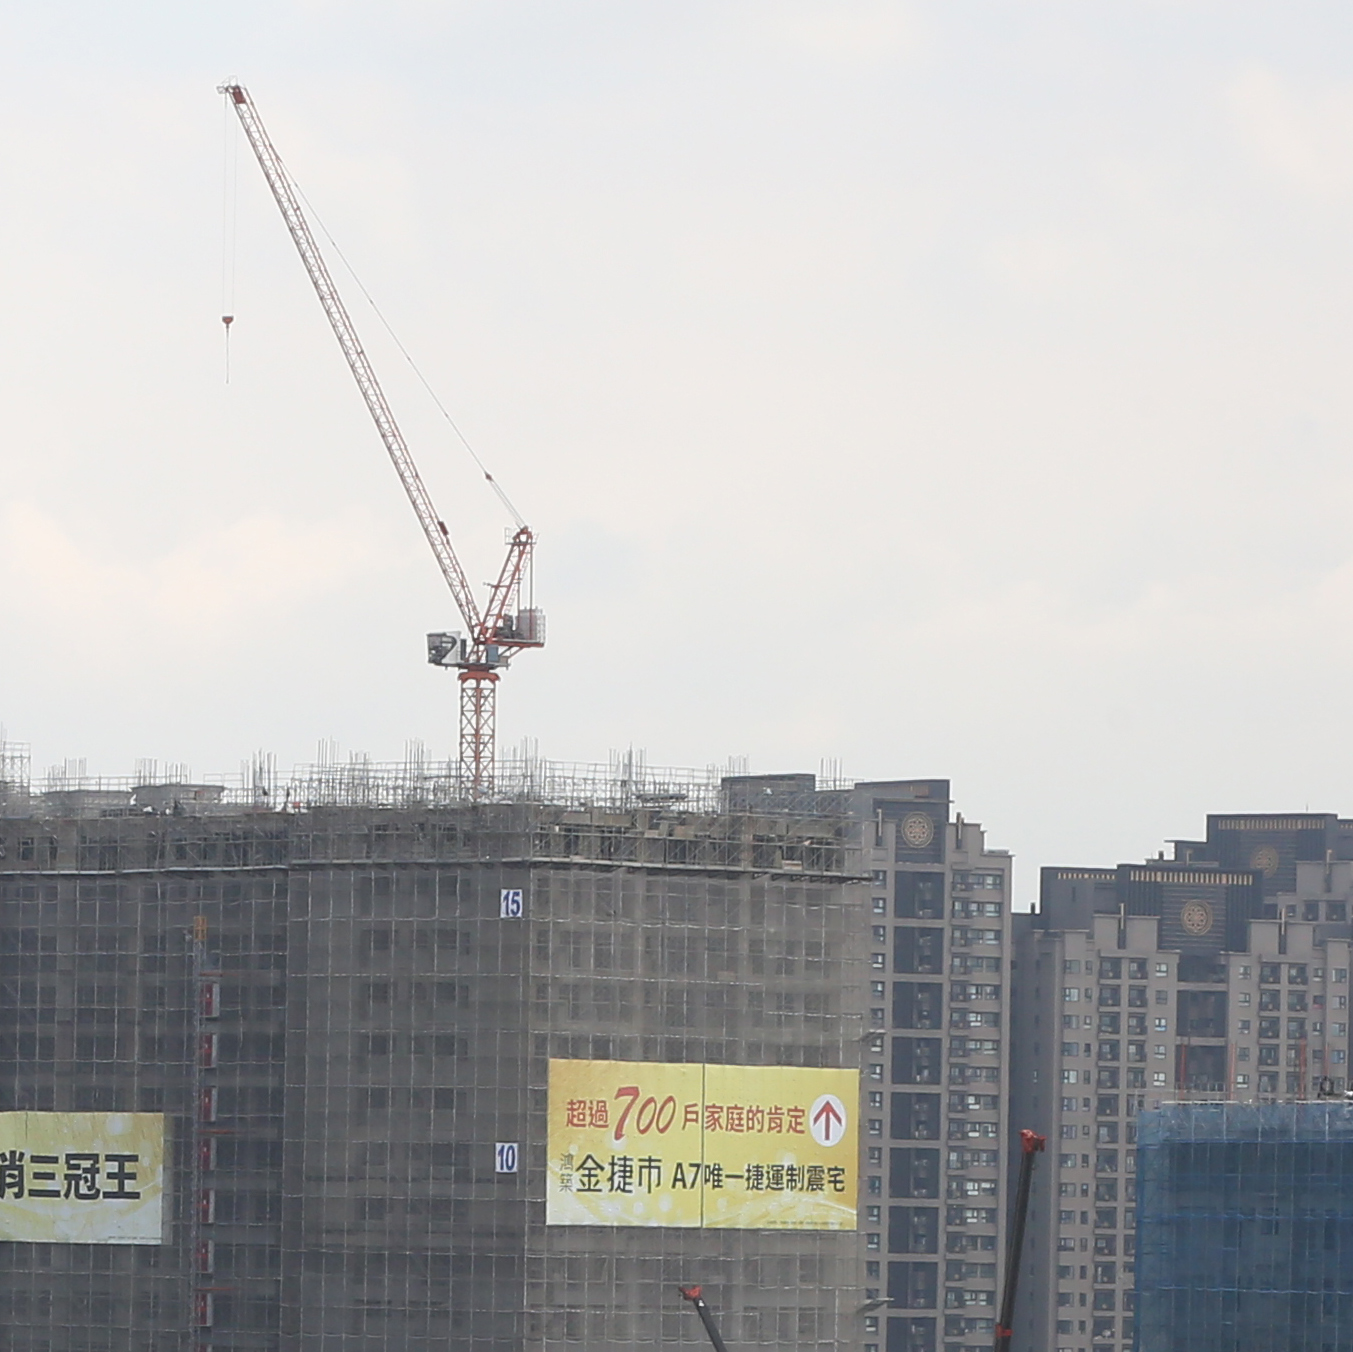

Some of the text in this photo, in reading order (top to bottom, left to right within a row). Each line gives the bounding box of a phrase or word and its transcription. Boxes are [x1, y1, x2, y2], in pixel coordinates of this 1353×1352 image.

[502, 890, 522, 918] 15
[566, 1086, 805, 1140] 超過700戶家庭的肯定
[498, 1143, 518, 1172] 10
[575, 1154, 846, 1194] 金捷市 A7唯一捷運制震宅
